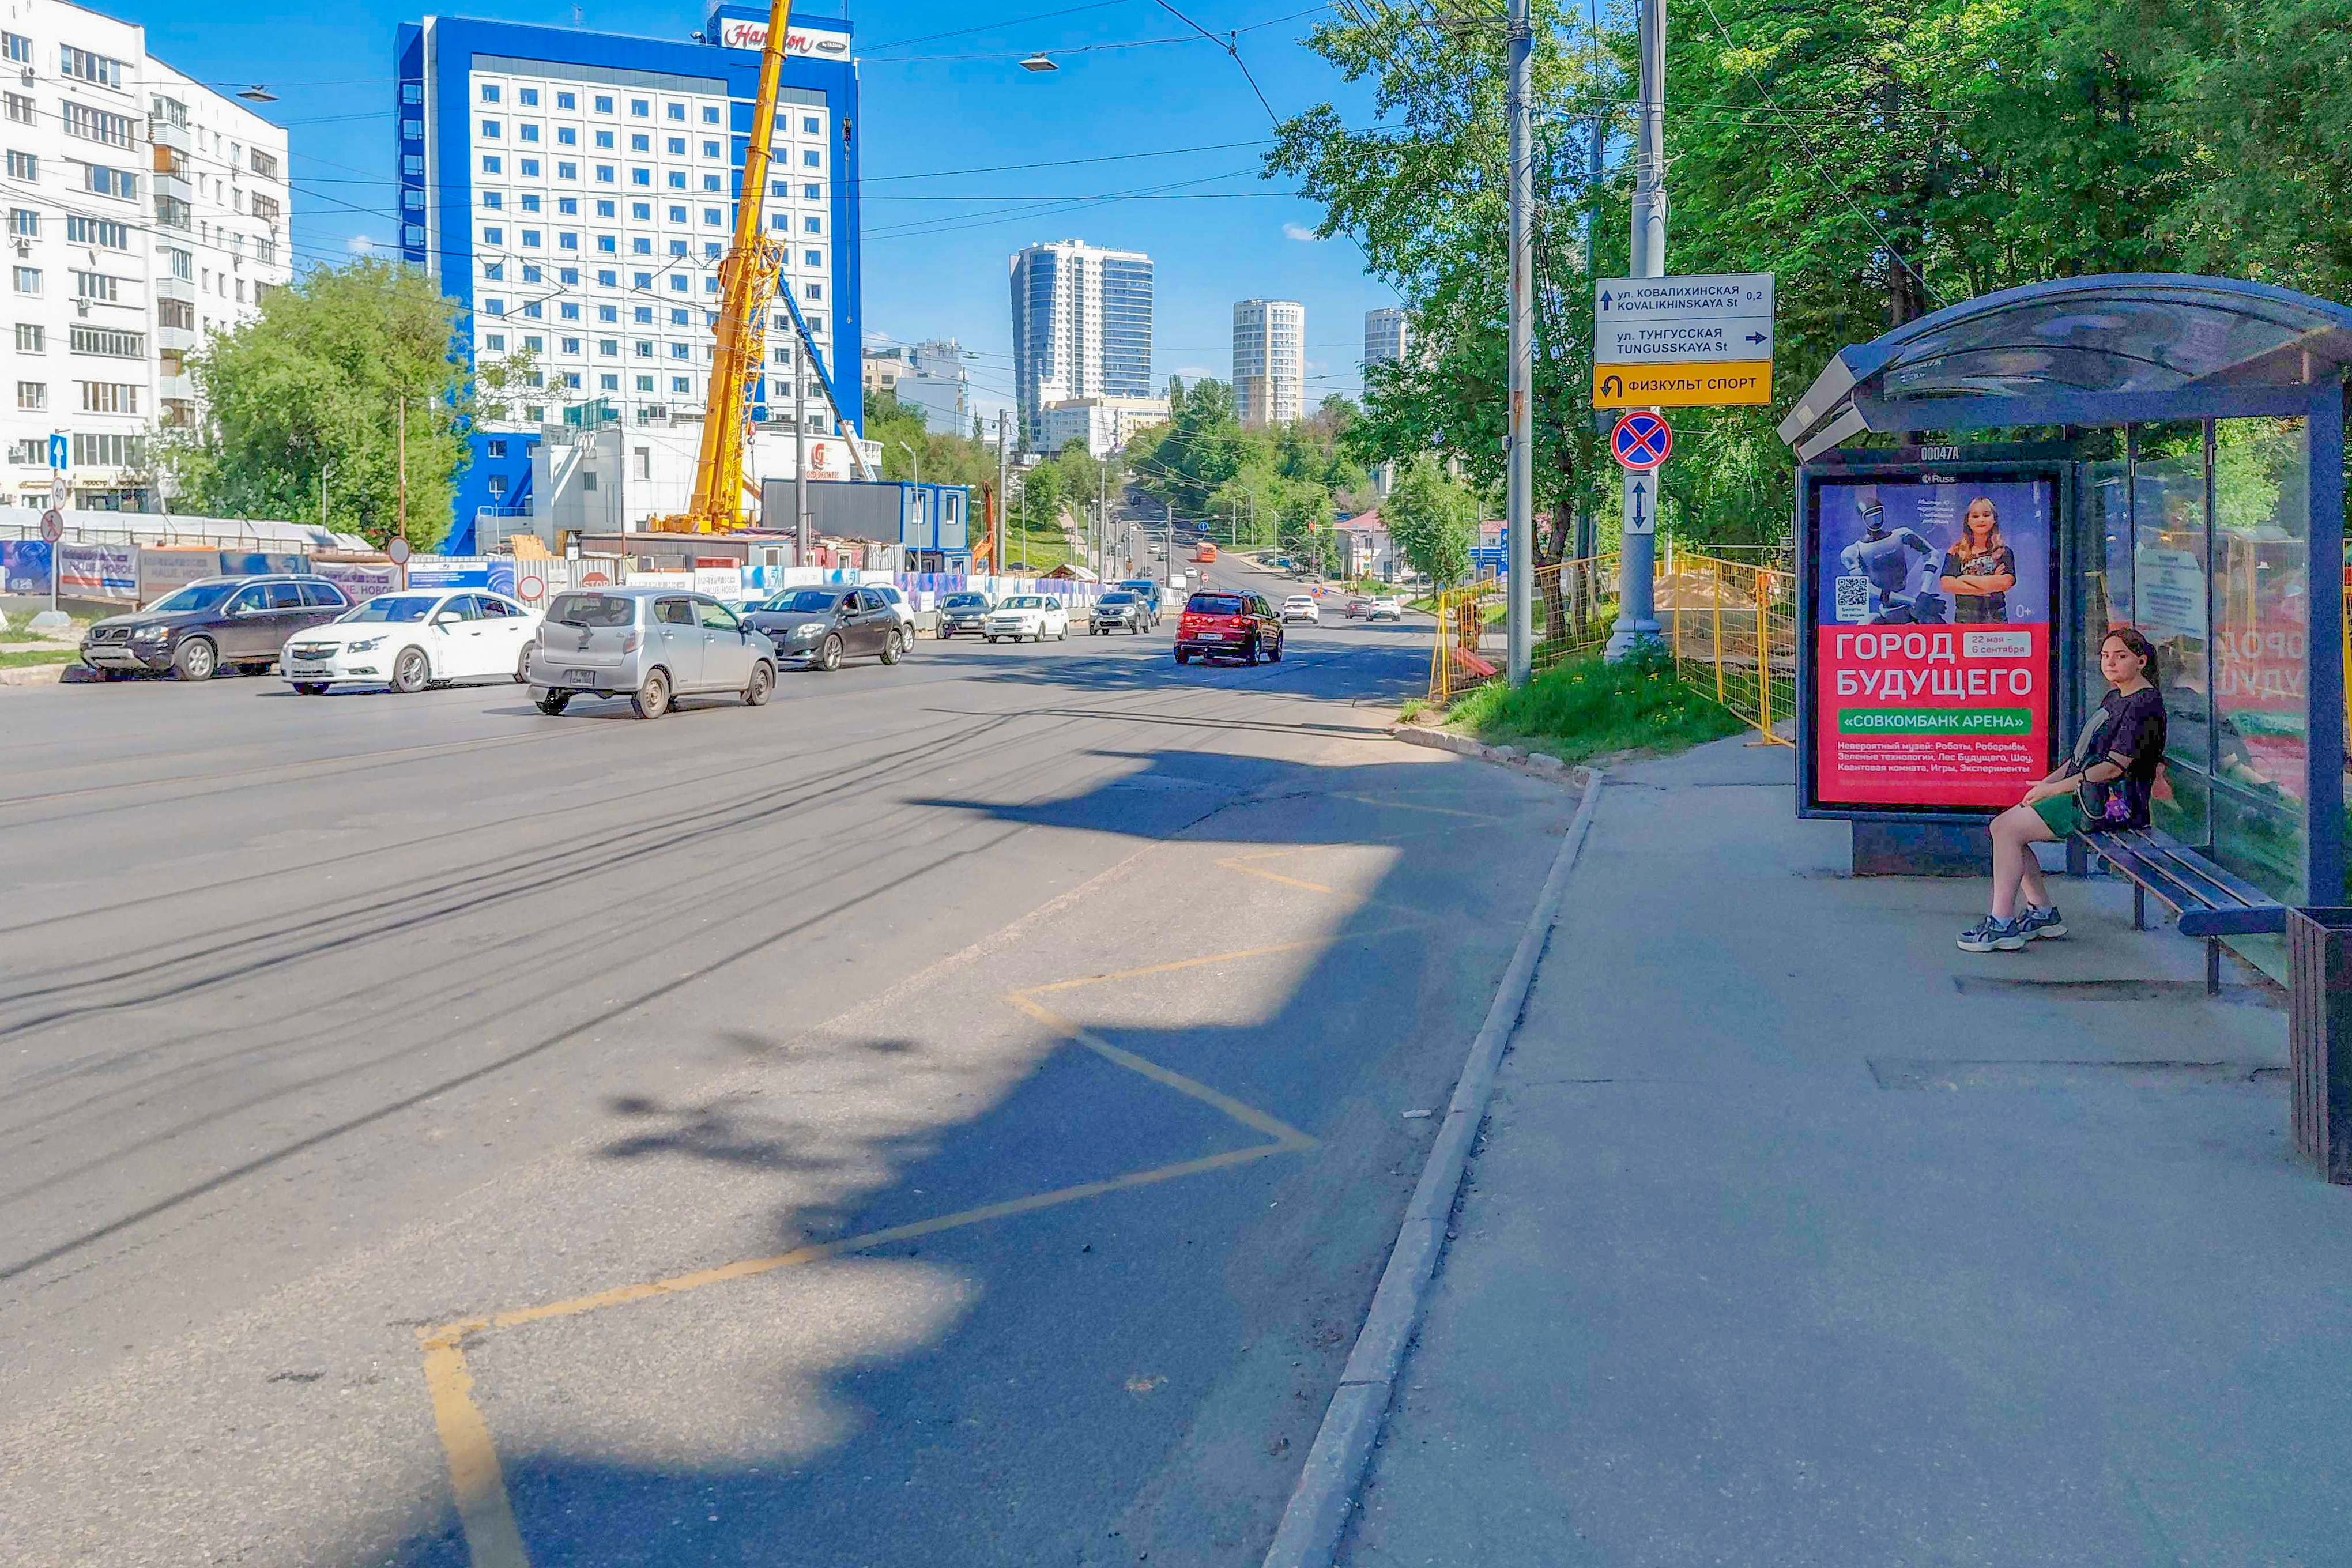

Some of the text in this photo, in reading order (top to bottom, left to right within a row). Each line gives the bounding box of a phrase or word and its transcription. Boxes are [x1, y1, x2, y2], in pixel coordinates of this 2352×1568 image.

[1618, 287, 1739, 300] ул. КОВАЛИХИНСКАЯ
[1747, 291, 1762, 301] 0,2
[1618, 299, 1737, 311] KOVALIKHINSKAYA St
[1617, 329, 1722, 342] ул. ТУНГУССКАЯ
[1617, 342, 1727, 354] TUNGUSSKAYA St
[1629, 378, 1757, 391] ФИЗКУЛЬТ СПОРТ
[1921, 447, 1959, 460] 00047A
[55, 487, 63, 500] 40
[2016, 605, 2031, 617] 0+
[1837, 633, 1955, 664] ГОРОД
[1981, 646, 2025, 654] сентября
[1837, 668, 2033, 700] БУДУЩЕГО
[1844, 715, 2023, 728] «СОВКОМБАНК АРЕНА»
[1838, 742, 1900, 751] Невероятный
[1902, 742, 1933, 752] музей:
[1958, 754, 2008, 763] Будущего,
[2010, 754, 2033, 763] Шоу,
[1960, 765, 2030, 773] Эксперименты
